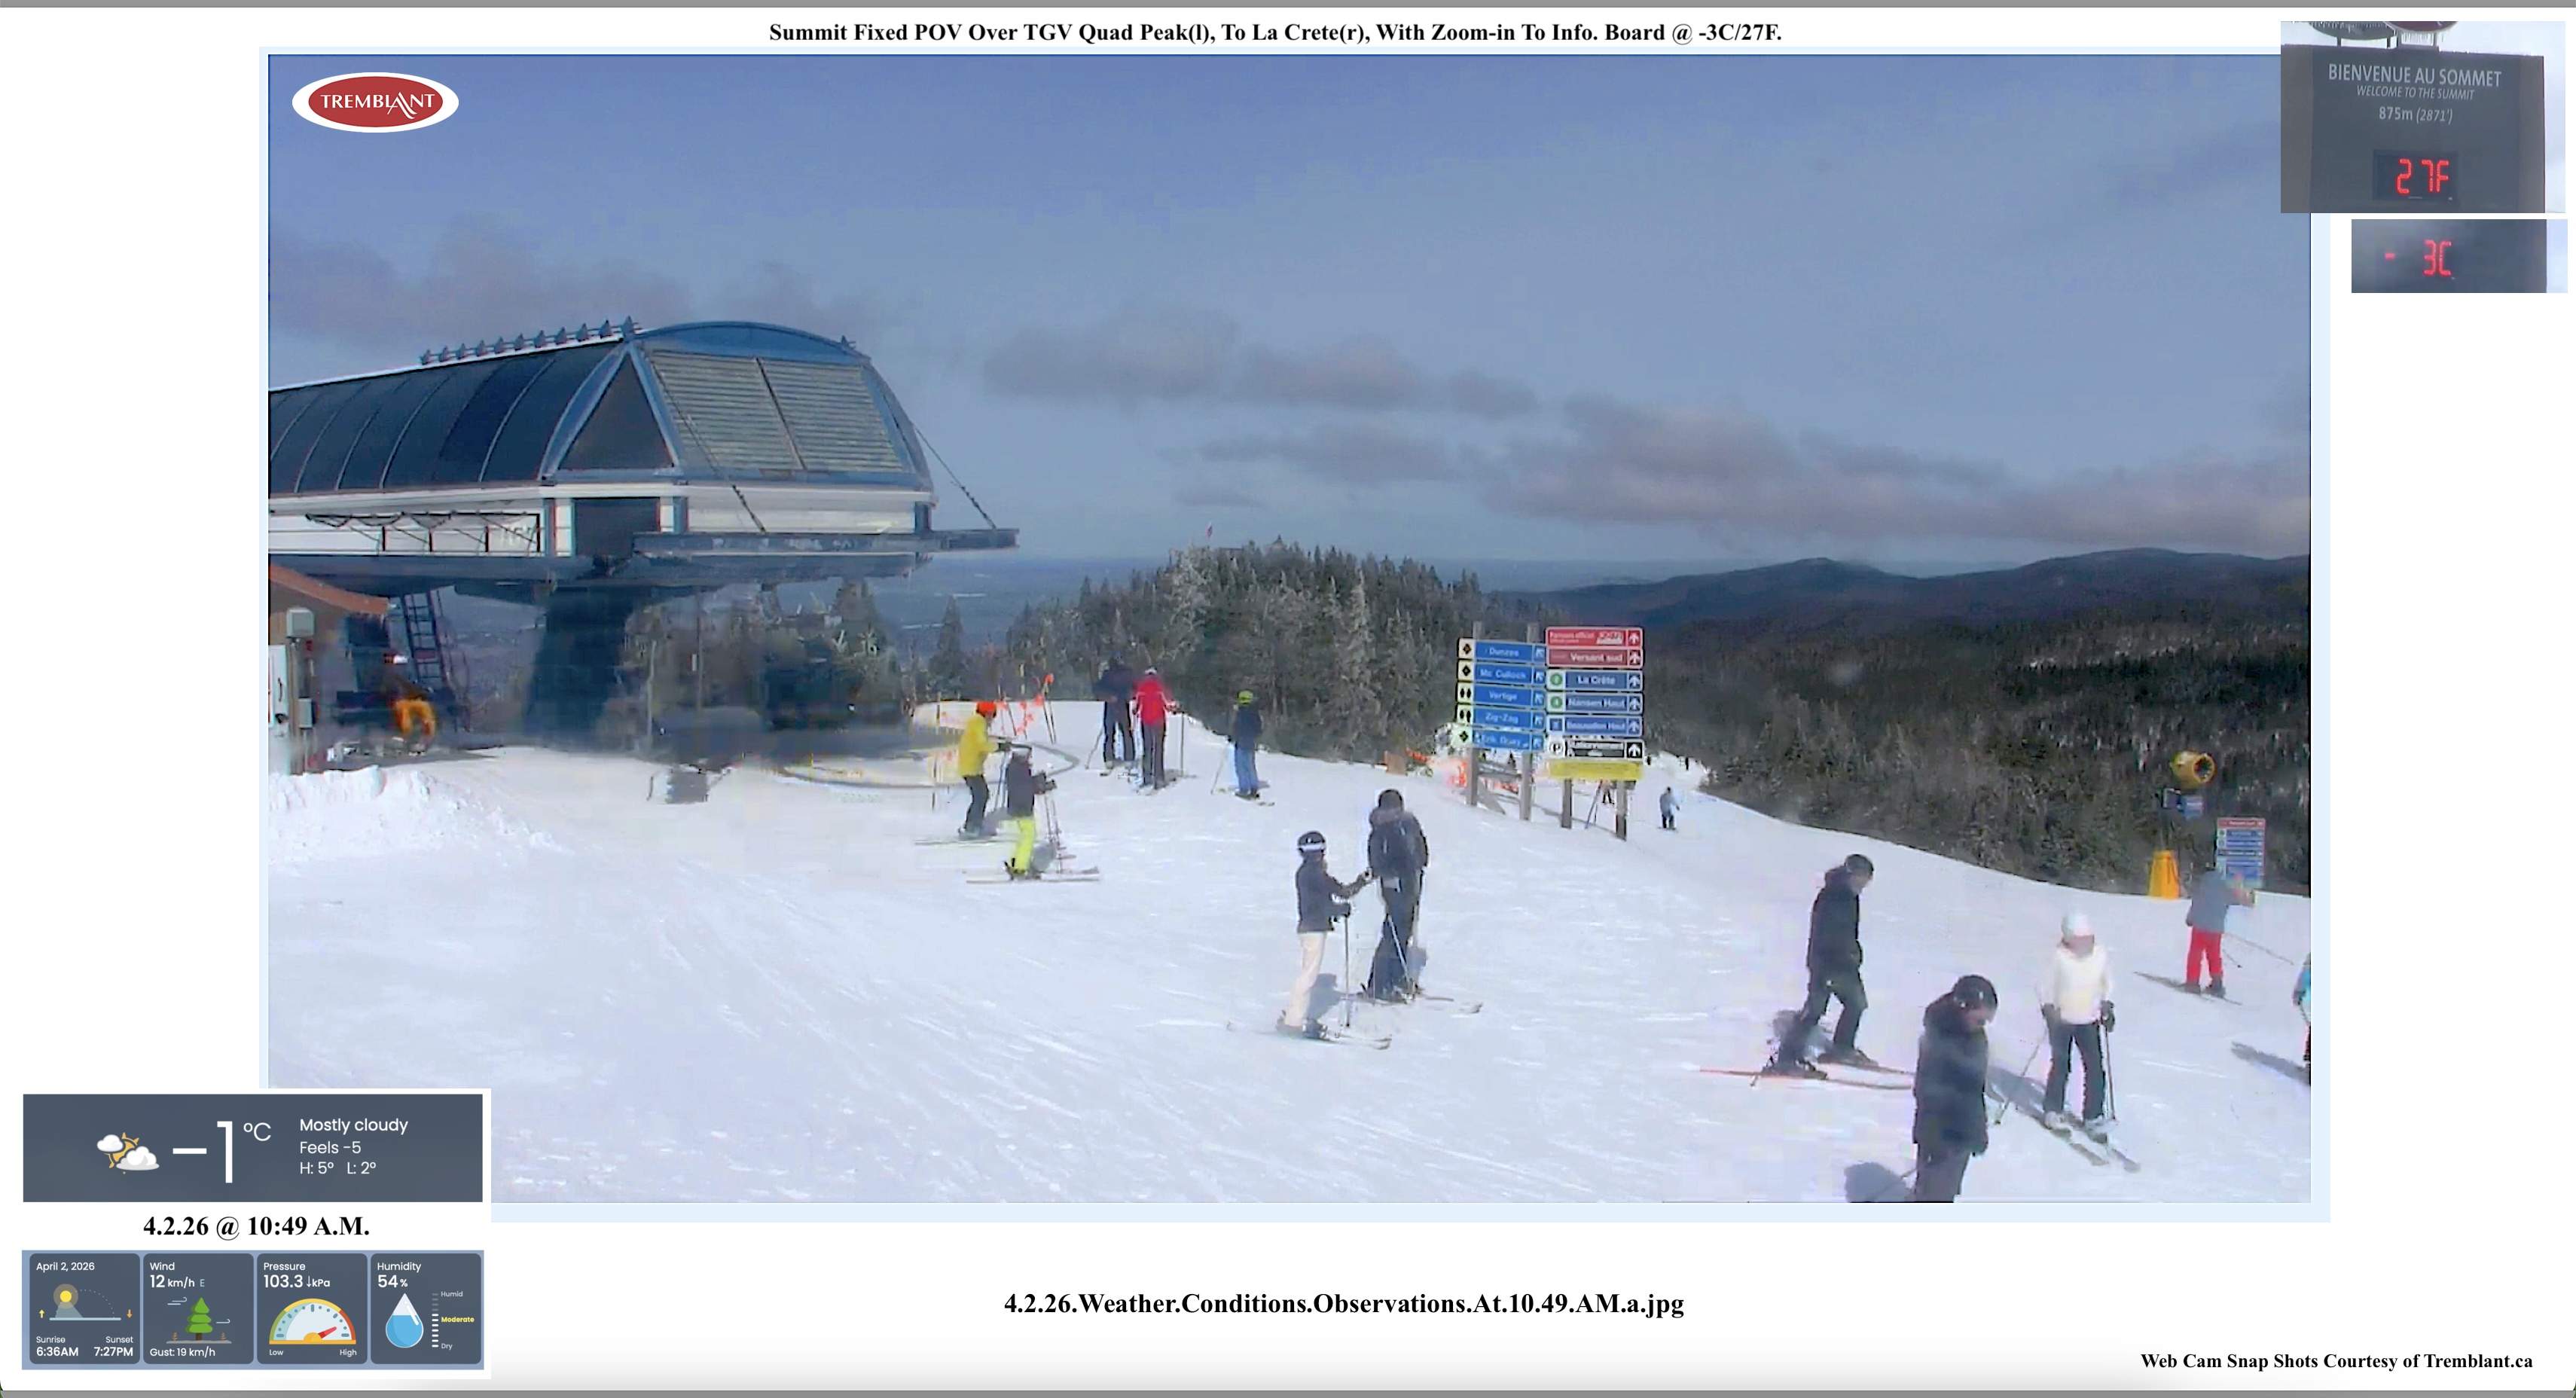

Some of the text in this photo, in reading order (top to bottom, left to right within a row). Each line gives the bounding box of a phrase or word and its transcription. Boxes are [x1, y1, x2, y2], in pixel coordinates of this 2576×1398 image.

[2328, 63, 2502, 87] BIENVENUE AU SOMMET
[2357, 85, 2475, 100] WELCOME TO THE SUMMIT
[2379, 106, 2453, 125] 875m (2871')
[1570, 652, 1624, 662] Versant sud
[1495, 669, 1527, 679] Culloch
[1577, 675, 1588, 684] La
[1488, 690, 1518, 701] Vertige
[1567, 697, 1626, 707] Nansen Haut
[1485, 712, 1519, 724] Zig-Zag
